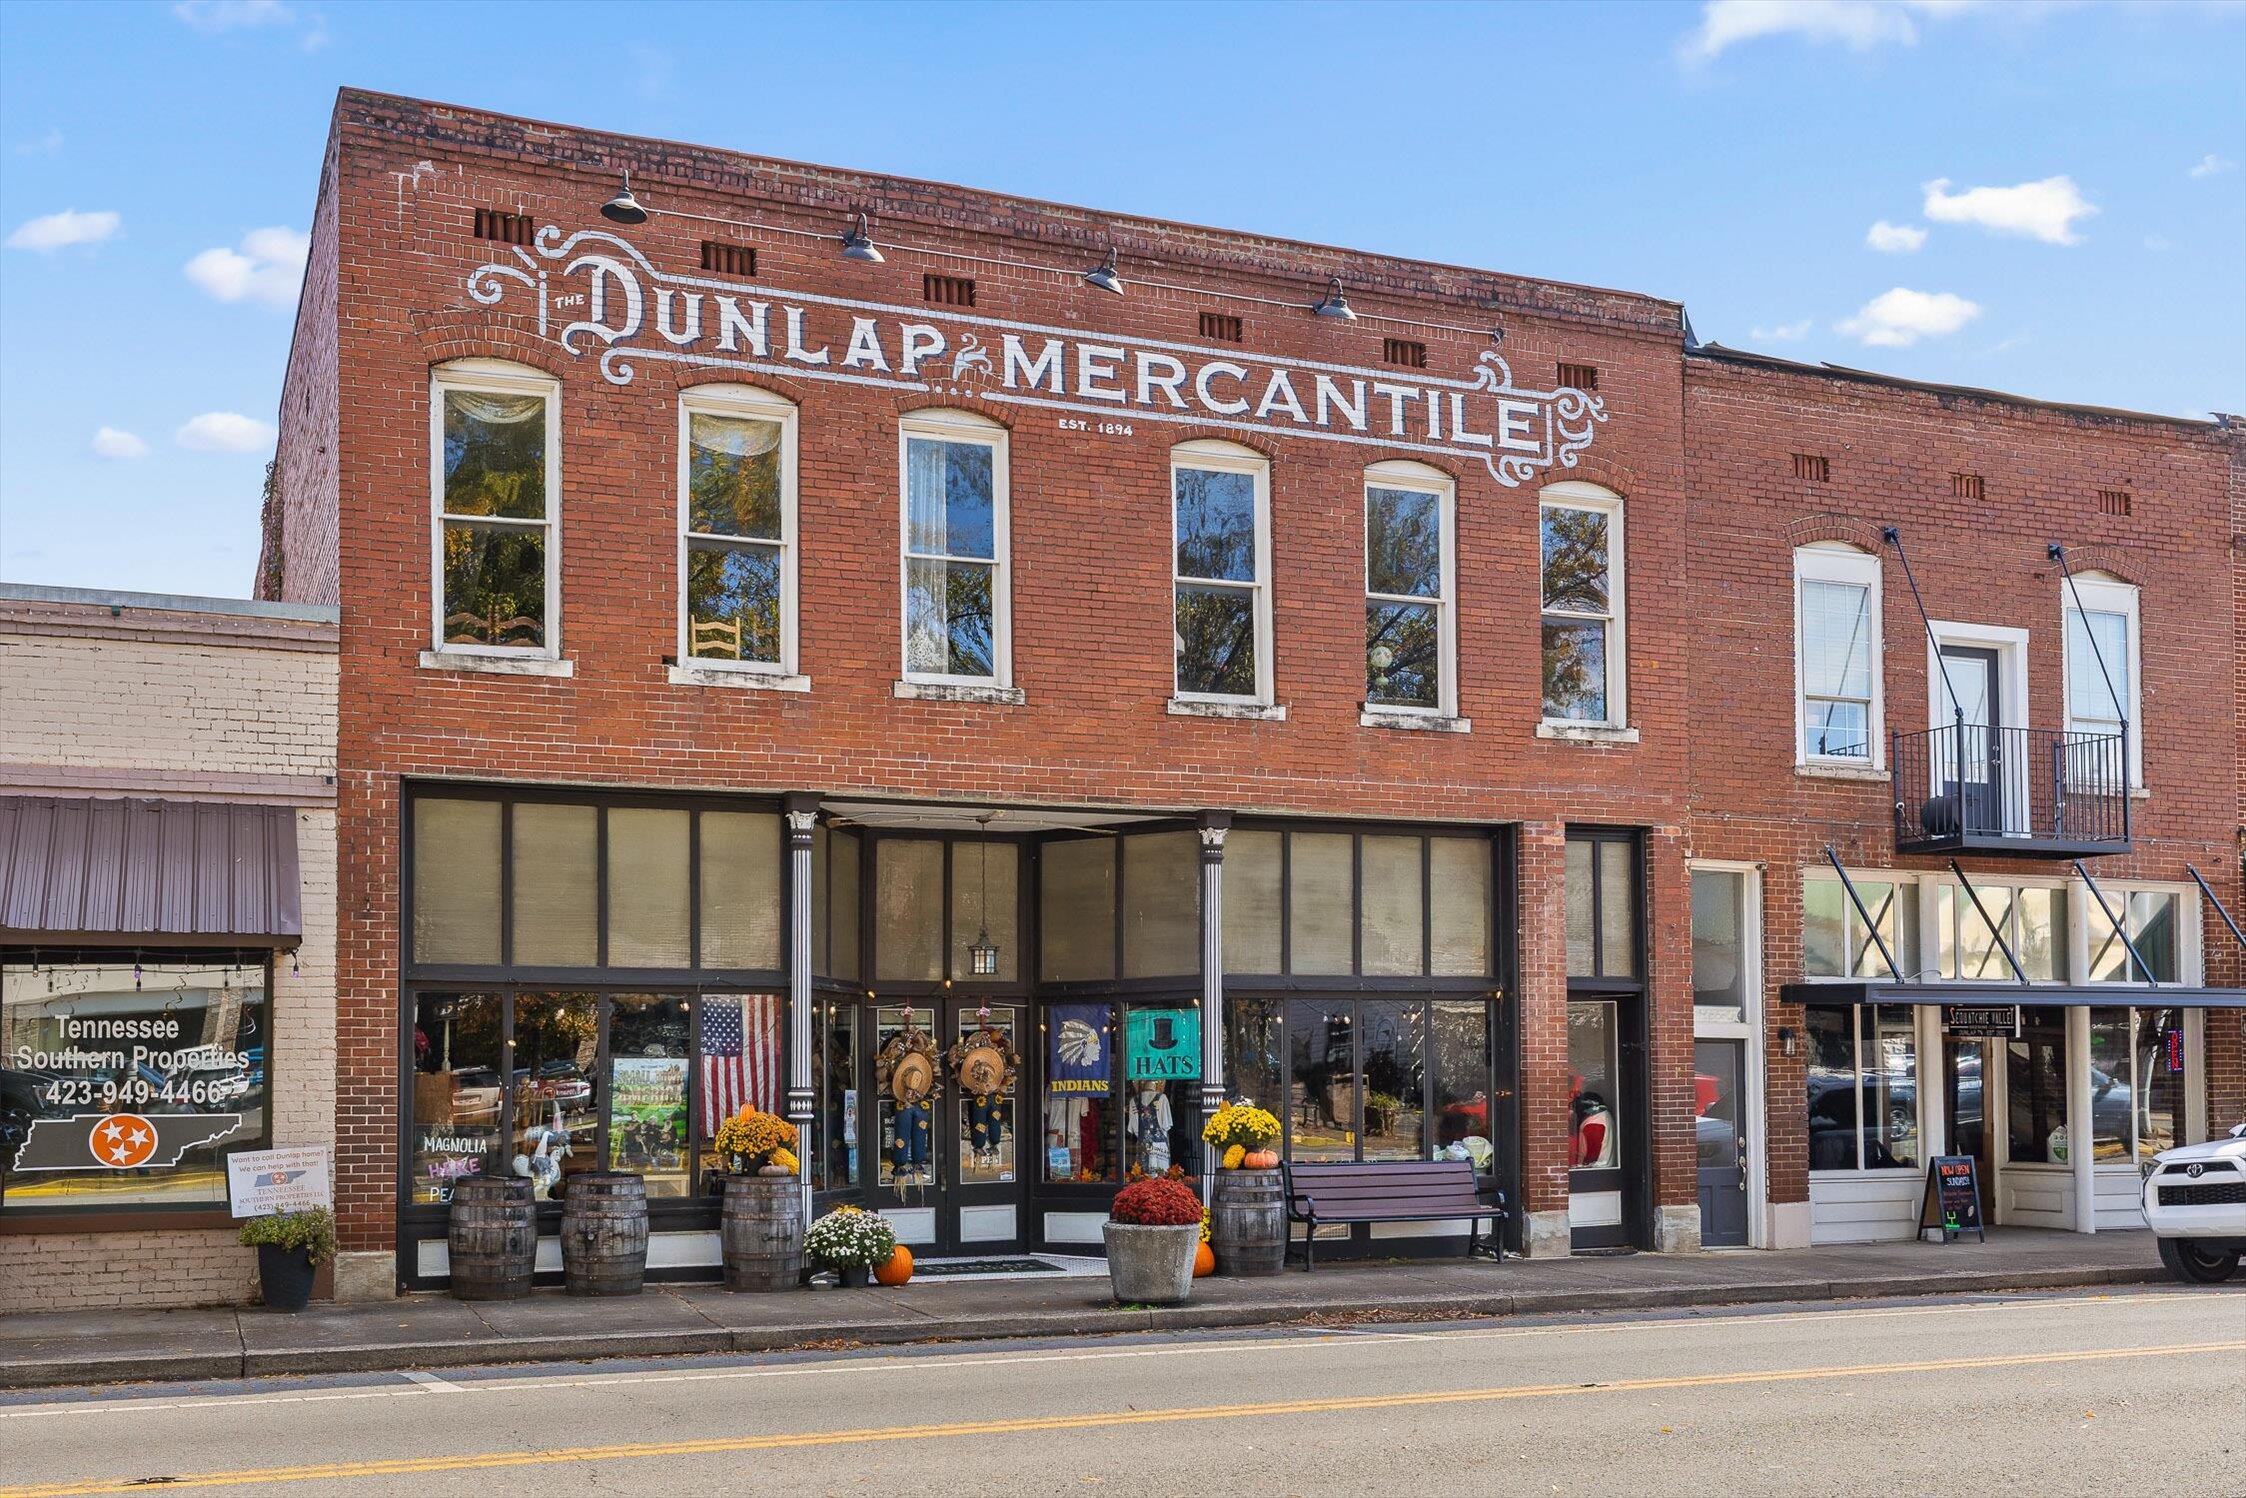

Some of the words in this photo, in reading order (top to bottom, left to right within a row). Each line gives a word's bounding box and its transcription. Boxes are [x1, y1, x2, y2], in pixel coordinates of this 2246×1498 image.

[554, 294, 585, 309] THE
[562, 255, 948, 376] DUNLAP
[1001, 333, 1540, 454] MERCANTILE
[1058, 418, 1091, 431] EST.
[1098, 422, 1133, 436] 1894
[1992, 1007, 2014, 1024] VALLEY
[55, 1014, 180, 1039] Tennessee
[17, 1045, 125, 1069] Southern
[133, 1045, 250, 1074] Properties
[1135, 1055, 1194, 1075] HATS
[46, 1080, 222, 1105] 423-949-4466
[1051, 1079, 1109, 1092] INDIANS
[423, 1136, 488, 1153] MAGNOLIA
[231, 1156, 250, 1164] Want
[262, 1154, 275, 1162] call
[276, 1151, 300, 1160] Dunlap
[302, 1149, 324, 1158] home?
[268, 1162, 284, 1170] help
[285, 1161, 300, 1169] with
